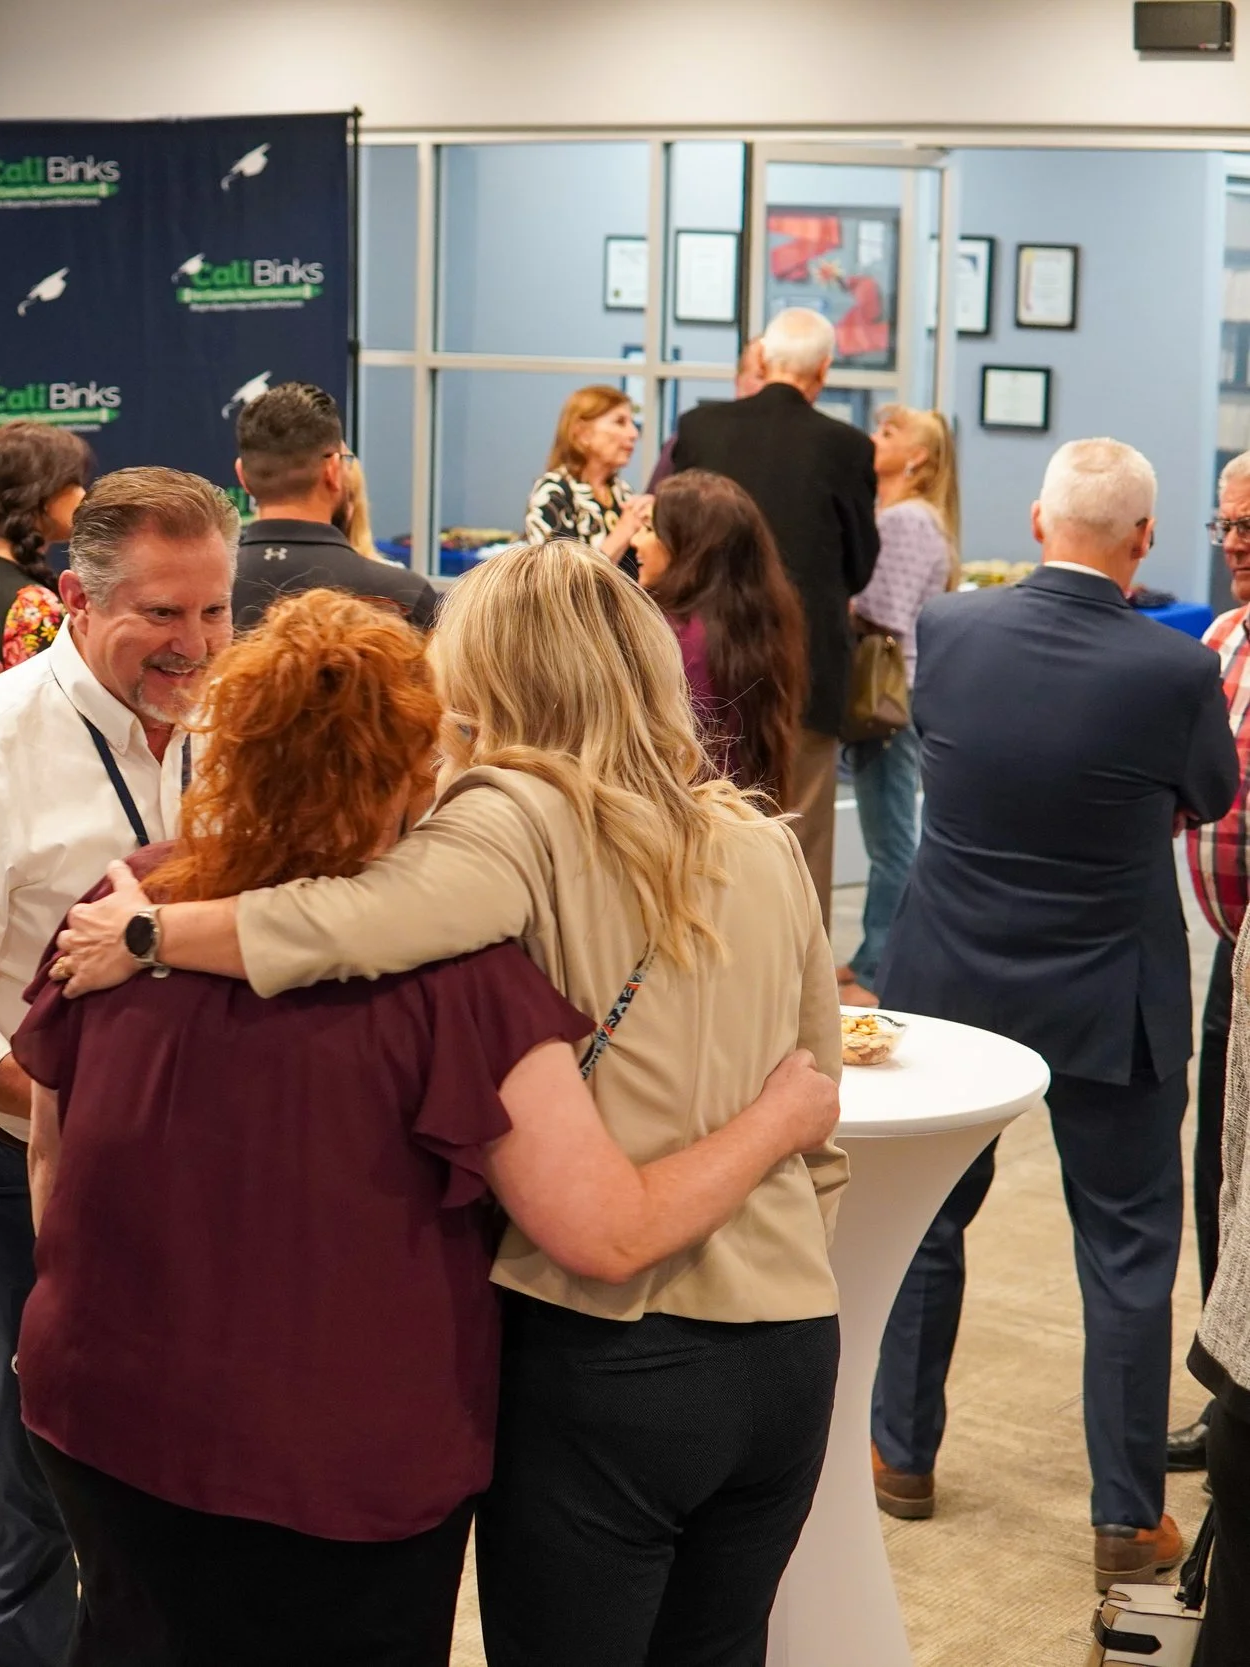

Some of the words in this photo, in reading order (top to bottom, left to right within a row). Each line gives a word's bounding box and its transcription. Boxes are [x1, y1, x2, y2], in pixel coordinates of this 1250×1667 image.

[47, 154, 120, 183] Binks
[191, 259, 250, 286] Cali
[253, 257, 324, 286] Binks
[50, 380, 121, 410] Binks
